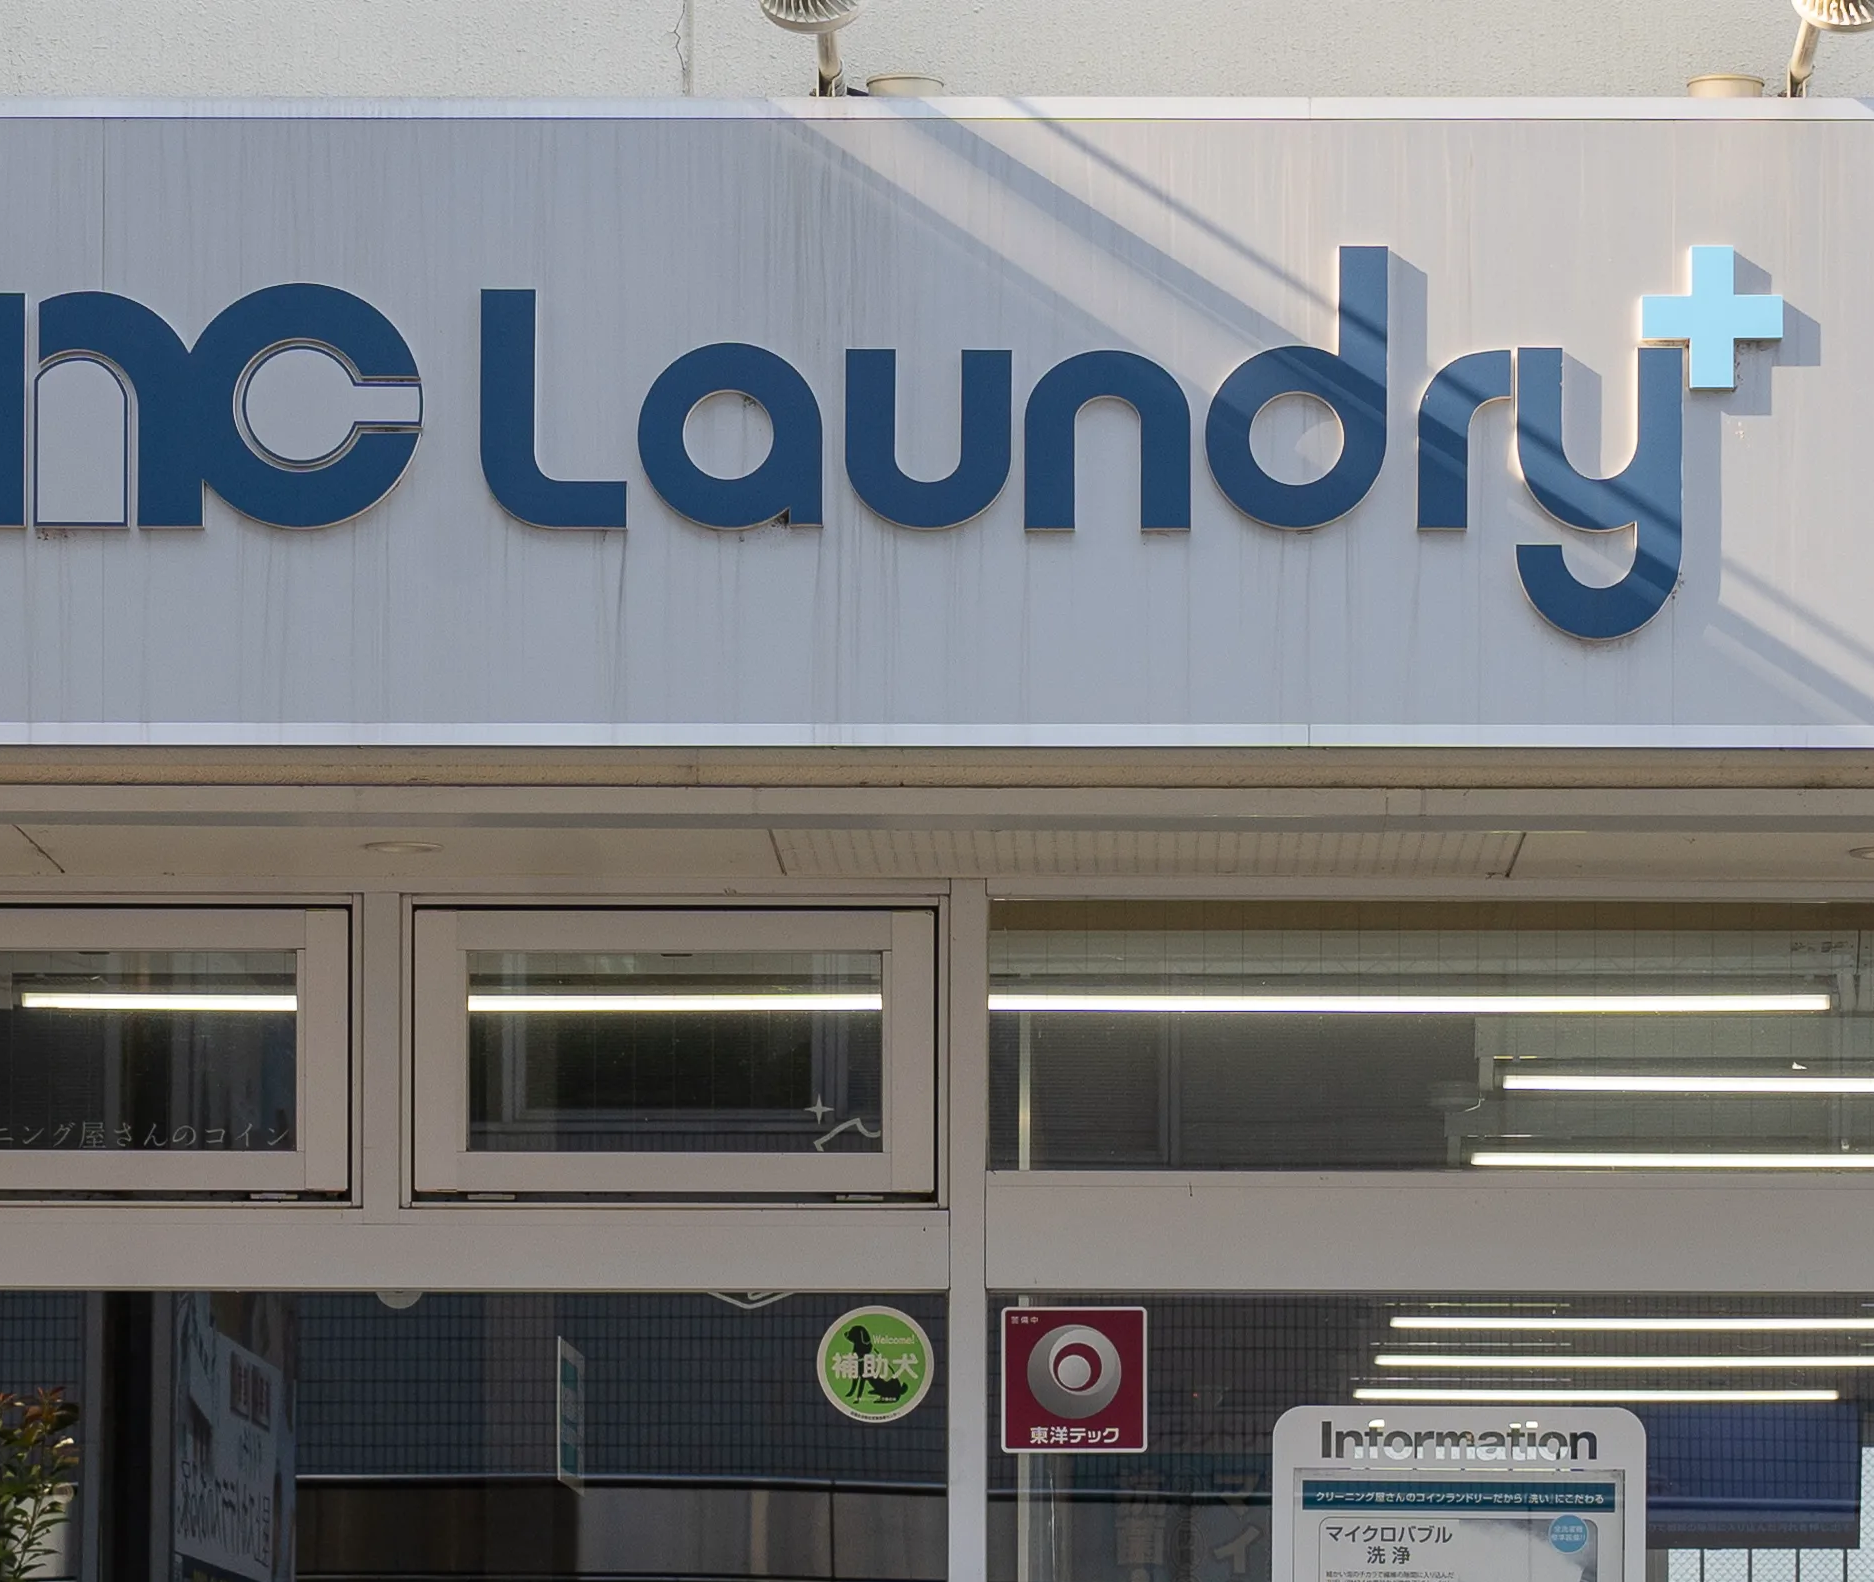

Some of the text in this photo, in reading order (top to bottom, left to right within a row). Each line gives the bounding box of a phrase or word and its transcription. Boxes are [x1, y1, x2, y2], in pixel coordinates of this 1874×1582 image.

[831, 1352, 919, 1380] 補助犬
[1029, 1426, 1120, 1445] 東洋テック
[1320, 1419, 1599, 1461] Information
[1326, 1525, 1453, 1544] マイクロバブル
[1366, 1545, 1411, 1565] 洗浄
